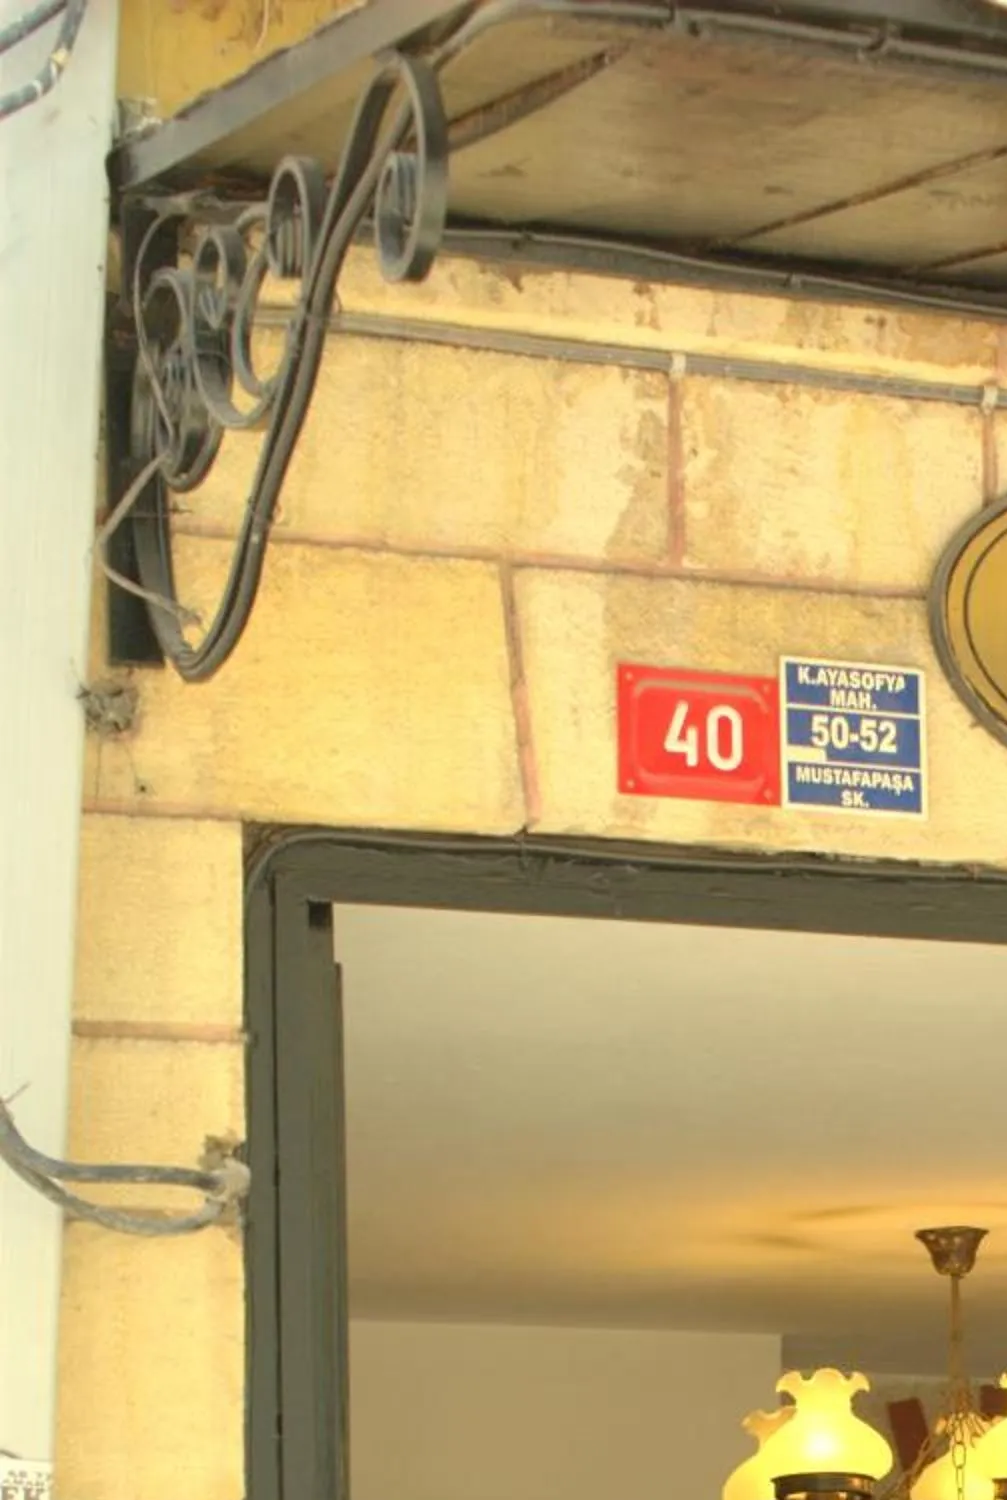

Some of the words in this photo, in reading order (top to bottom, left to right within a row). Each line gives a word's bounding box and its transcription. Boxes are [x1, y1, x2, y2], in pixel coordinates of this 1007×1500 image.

[798, 666, 905, 692] K.AYASOFYA
[830, 690, 877, 710] MAH.
[664, 700, 743, 771] 40
[811, 715, 897, 753] 50-52
[795, 766, 914, 796] MUSTAFAPAŞA
[841, 791, 869, 808] SK.
